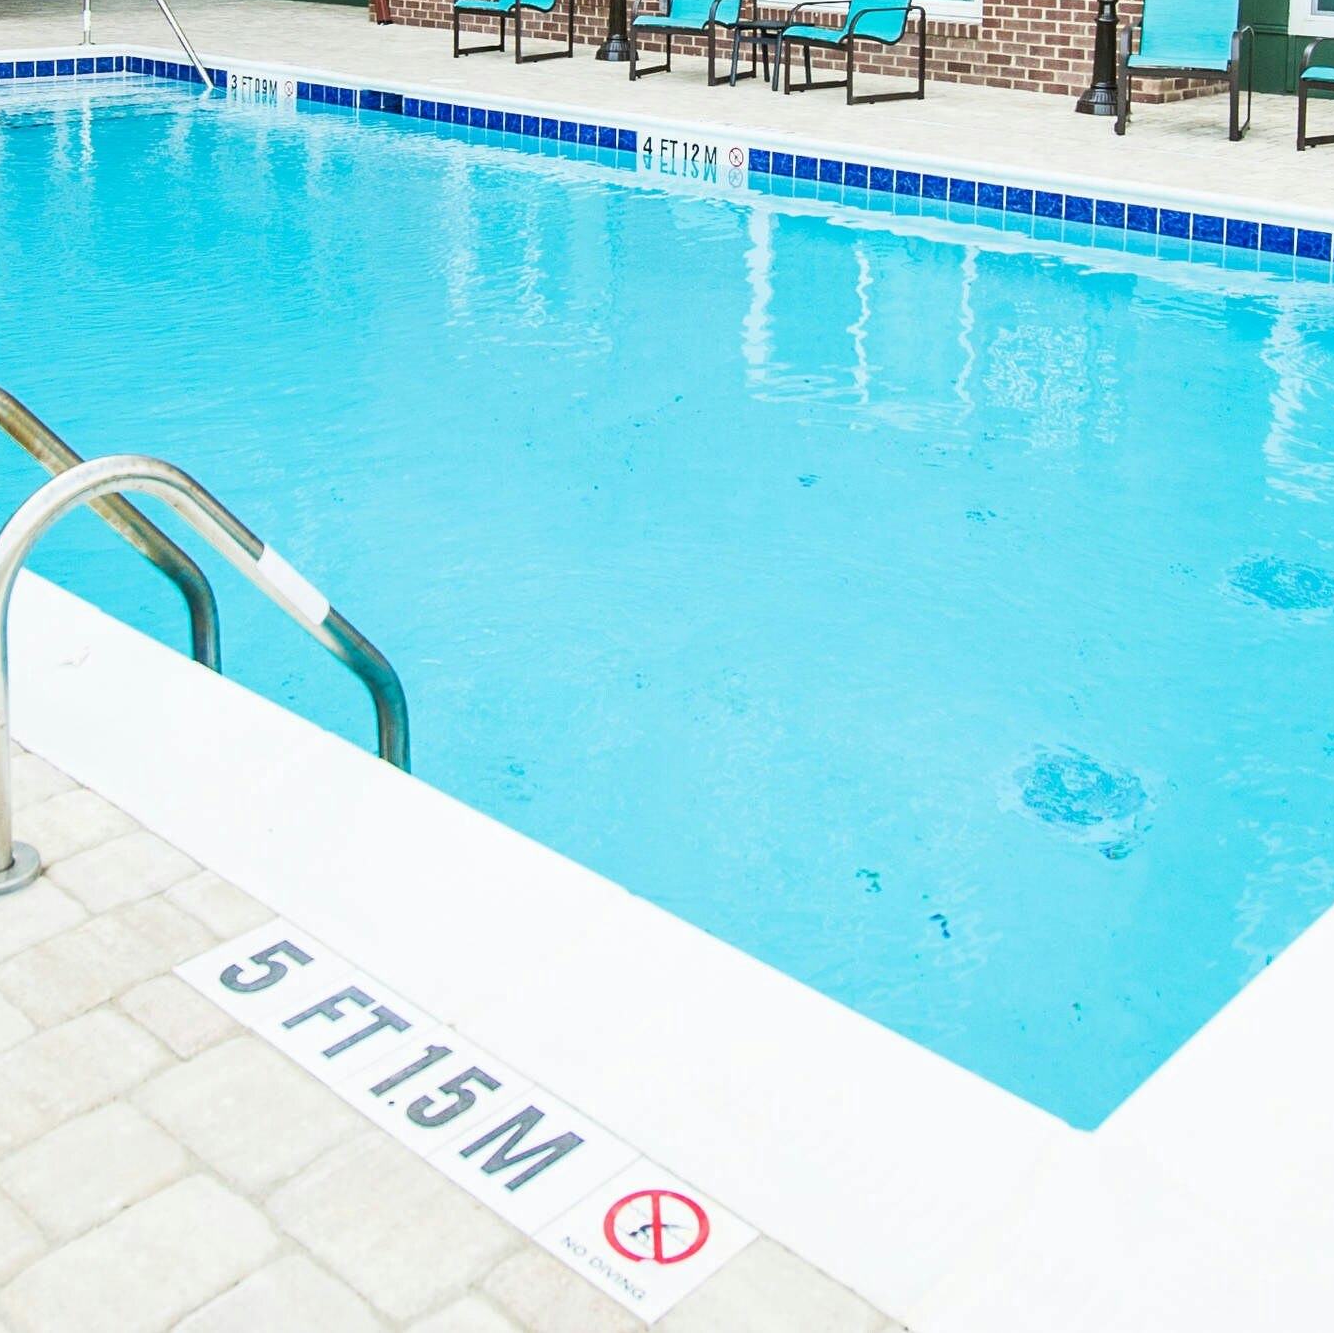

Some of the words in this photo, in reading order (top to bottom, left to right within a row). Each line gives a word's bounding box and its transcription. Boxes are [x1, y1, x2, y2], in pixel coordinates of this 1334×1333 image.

[231, 74, 238, 89] 3
[269, 79, 277, 95] M
[643, 136, 653, 155] 4
[661, 138, 678, 159] FT
[704, 145, 717, 165] M
[219, 939, 314, 993] 5
[281, 984, 412, 1059] FT
[459, 1104, 585, 1193] M
[561, 1236, 587, 1256] NO
[589, 1256, 647, 1301] DIVING
